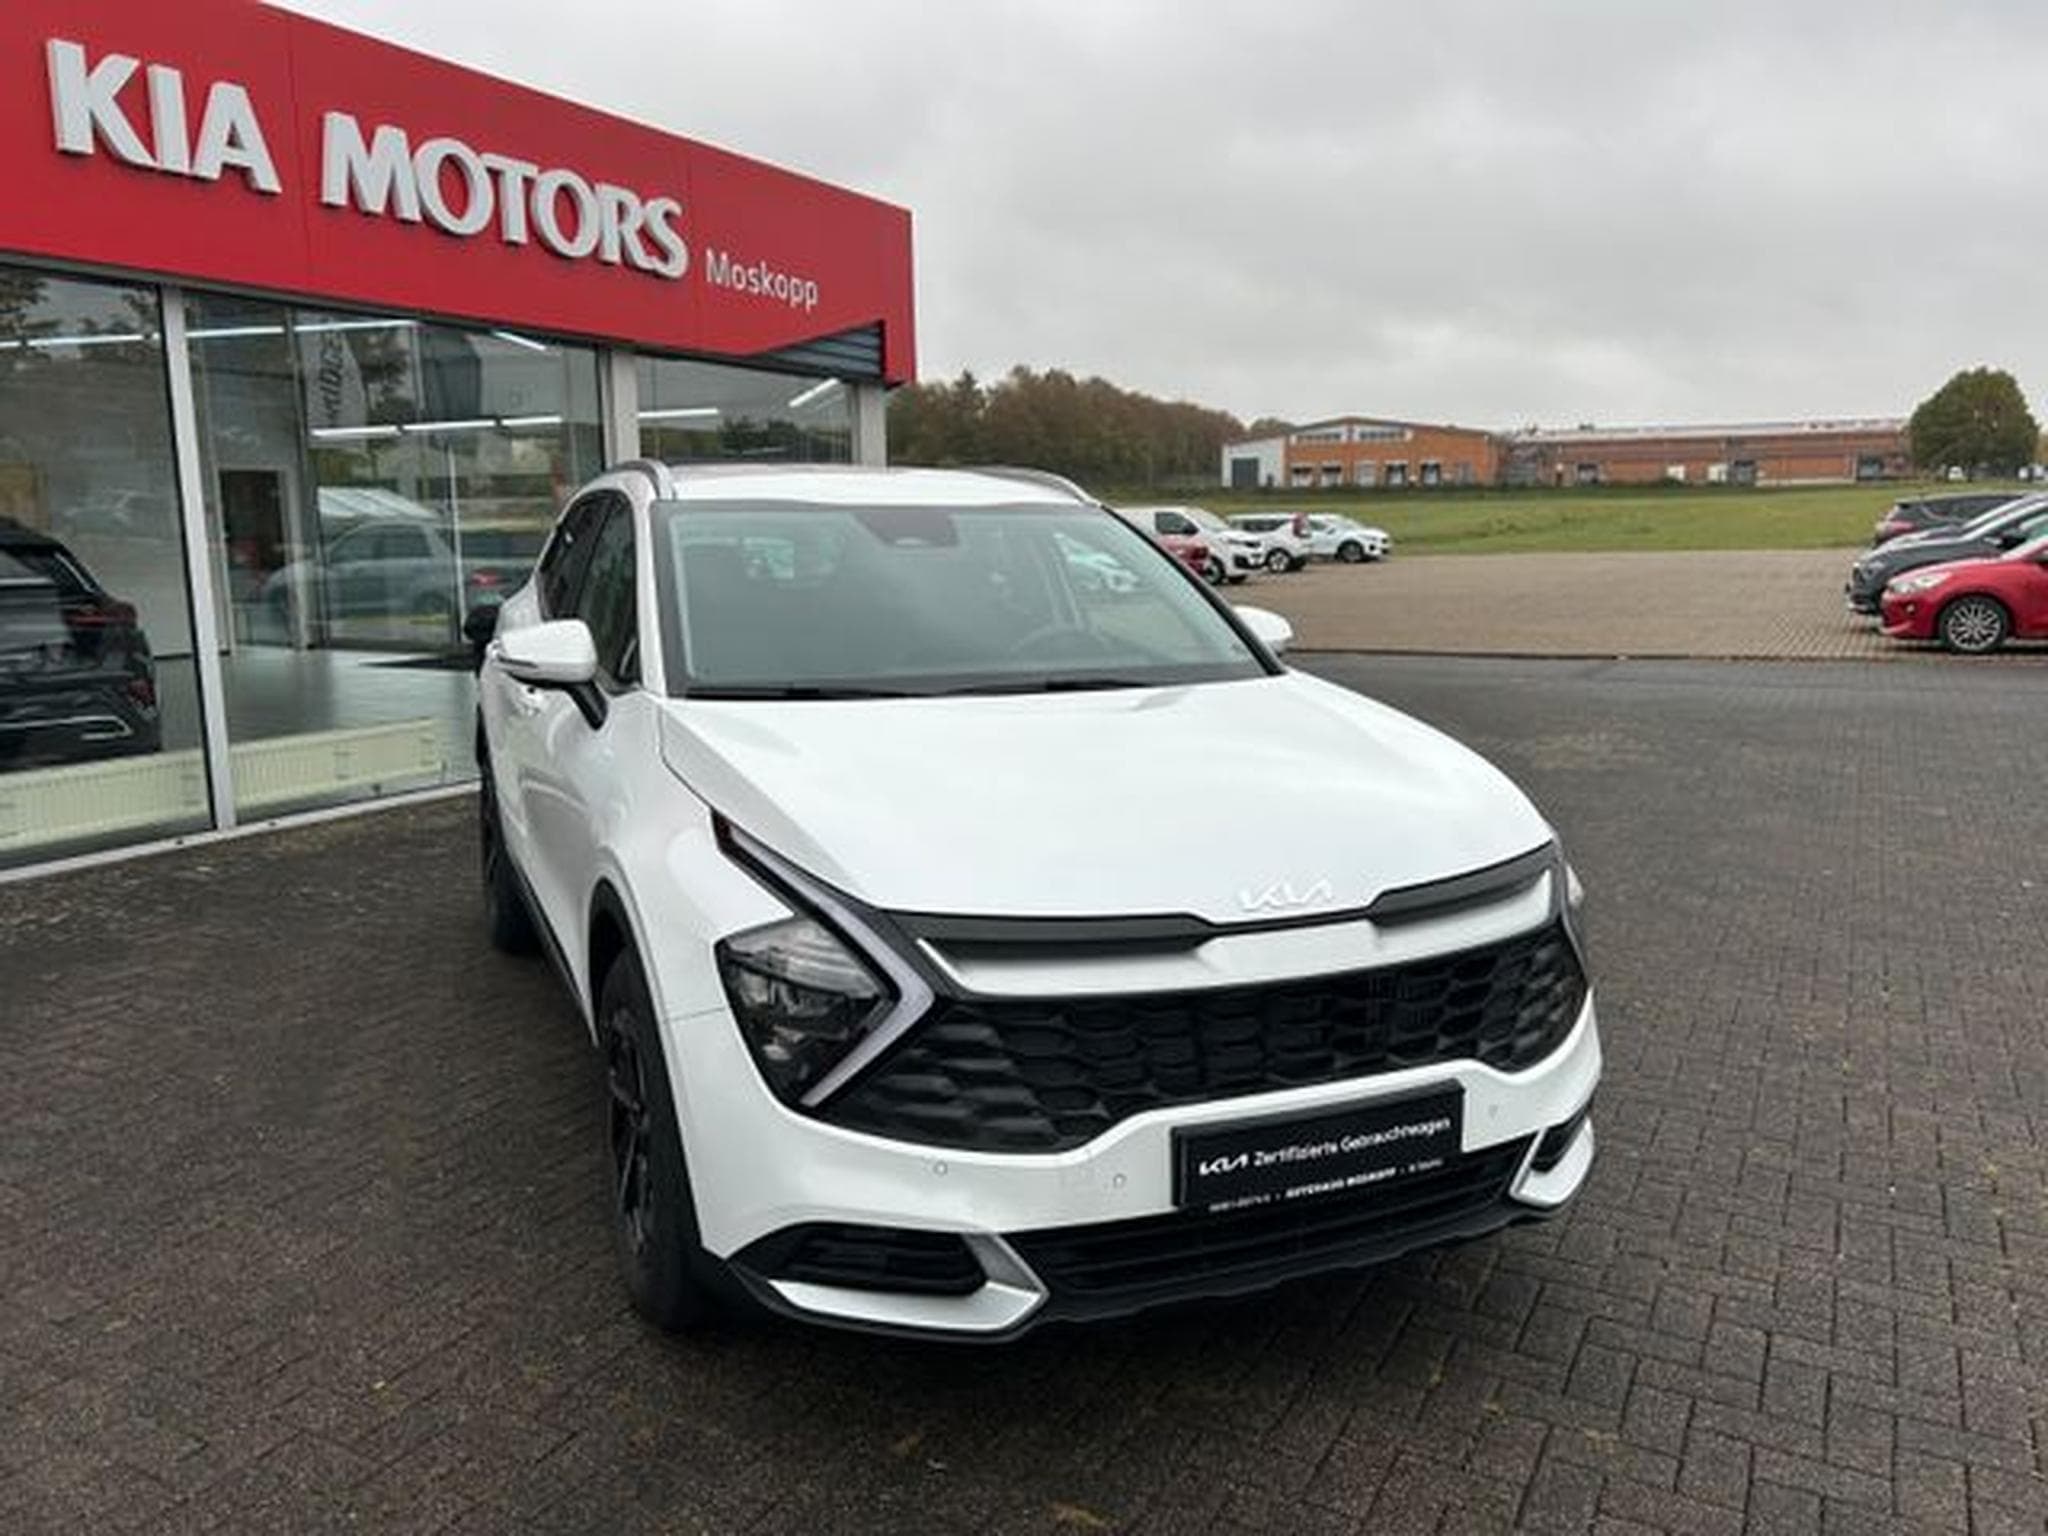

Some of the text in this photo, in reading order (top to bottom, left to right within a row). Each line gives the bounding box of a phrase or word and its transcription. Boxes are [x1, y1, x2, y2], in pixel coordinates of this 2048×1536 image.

[46, 38, 689, 280] KIA MOTORS
[706, 247, 818, 314] Moskopp
[1199, 1152, 1249, 1176] KIA
[1340, 1117, 1451, 1153] Gebrauchtwagen
